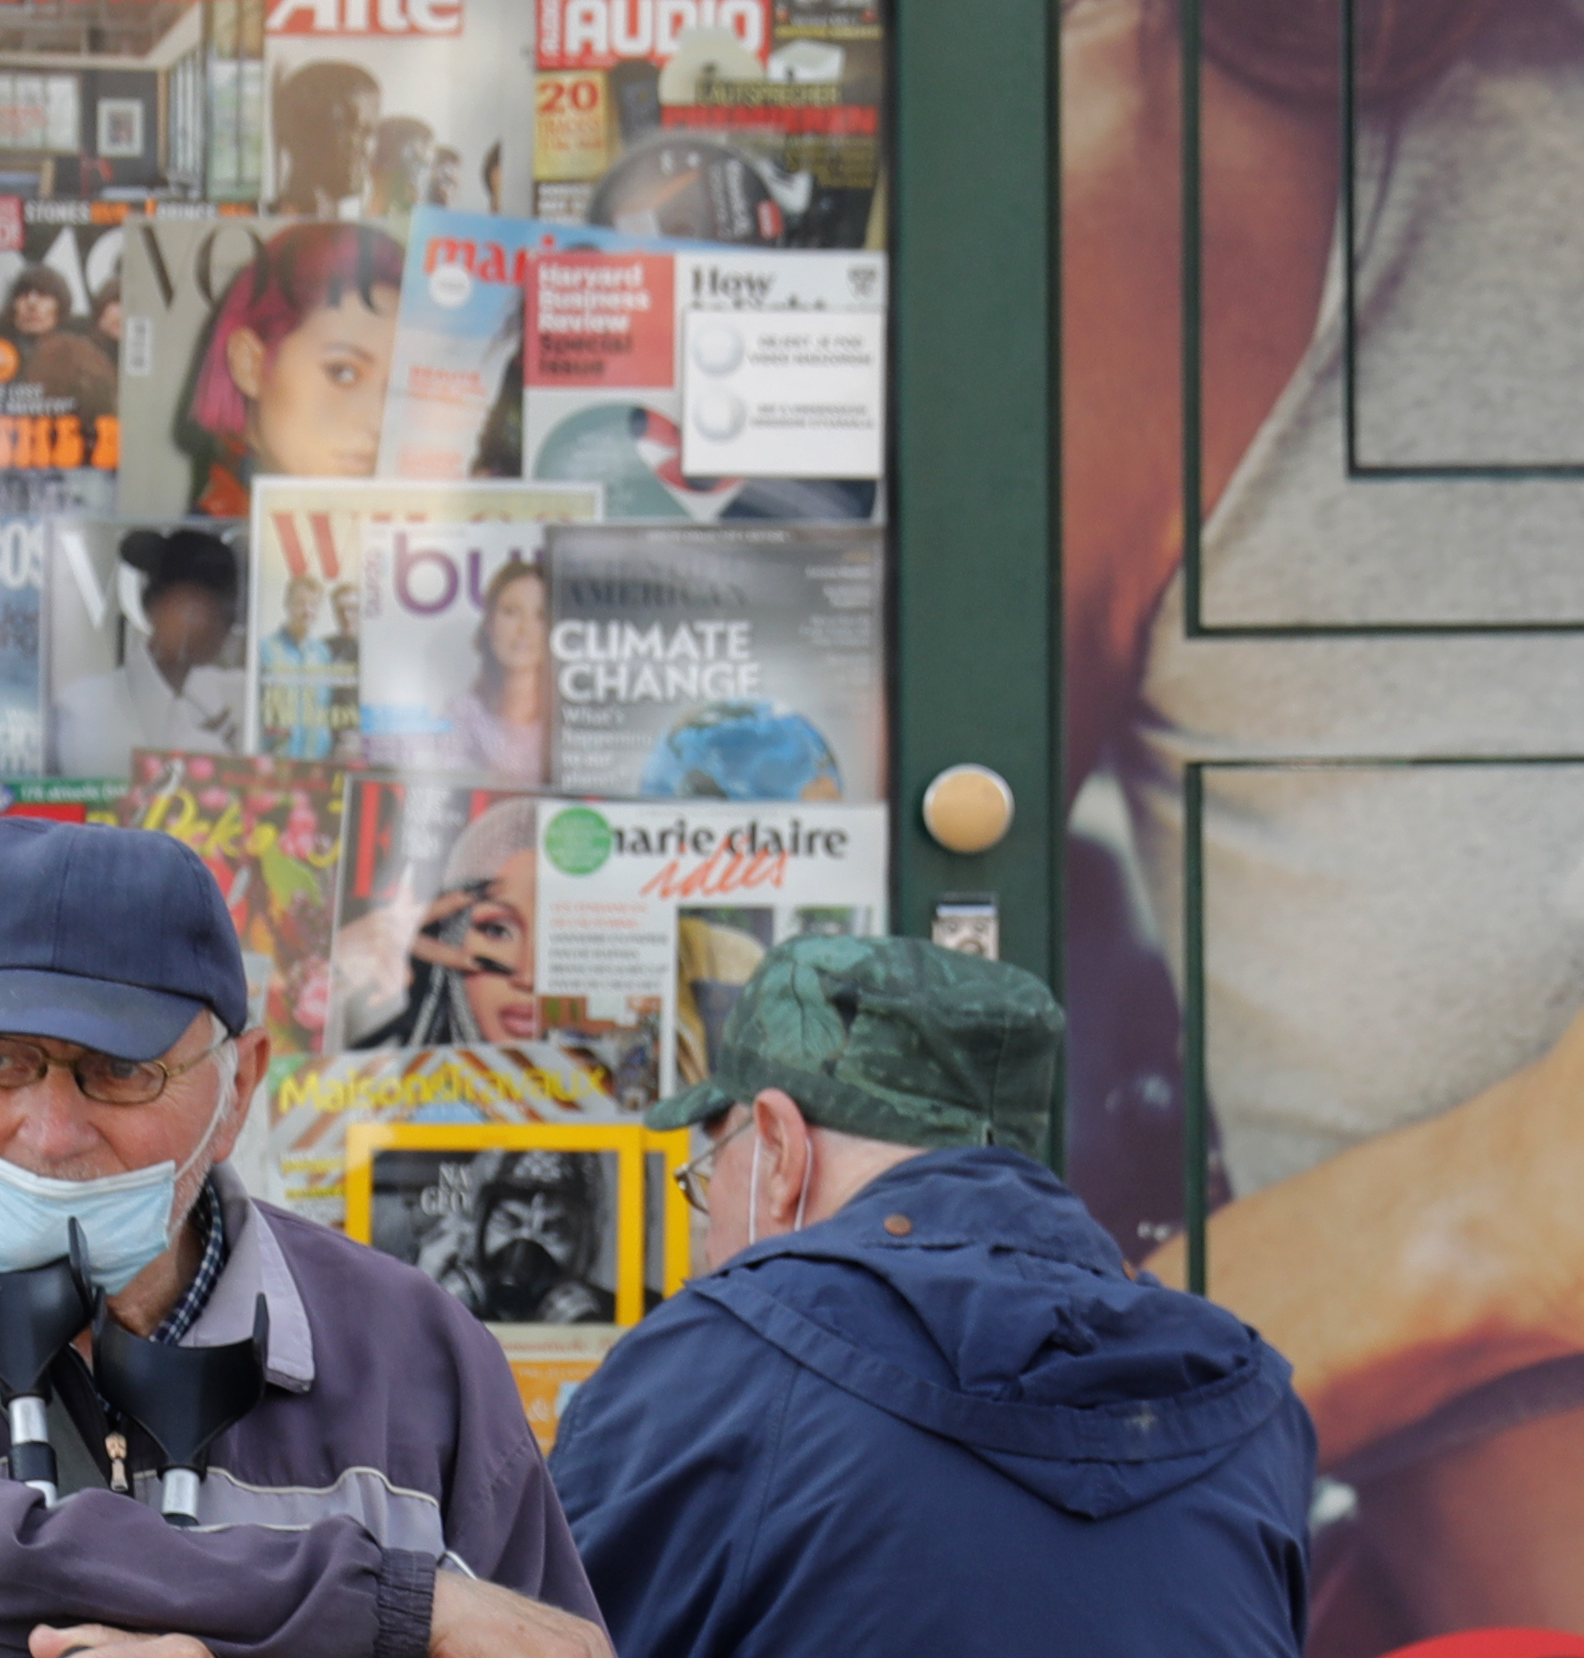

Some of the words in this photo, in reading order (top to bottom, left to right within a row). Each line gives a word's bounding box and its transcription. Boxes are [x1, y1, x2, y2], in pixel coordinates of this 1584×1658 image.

[537, 80, 599, 113] 20
[538, 261, 644, 289] Harvard
[692, 265, 774, 298] How
[538, 288, 651, 312] Business
[538, 311, 631, 335] Review
[549, 618, 752, 664] CLIMATE
[557, 662, 761, 703] CHANGE
[726, 817, 850, 858] claire
